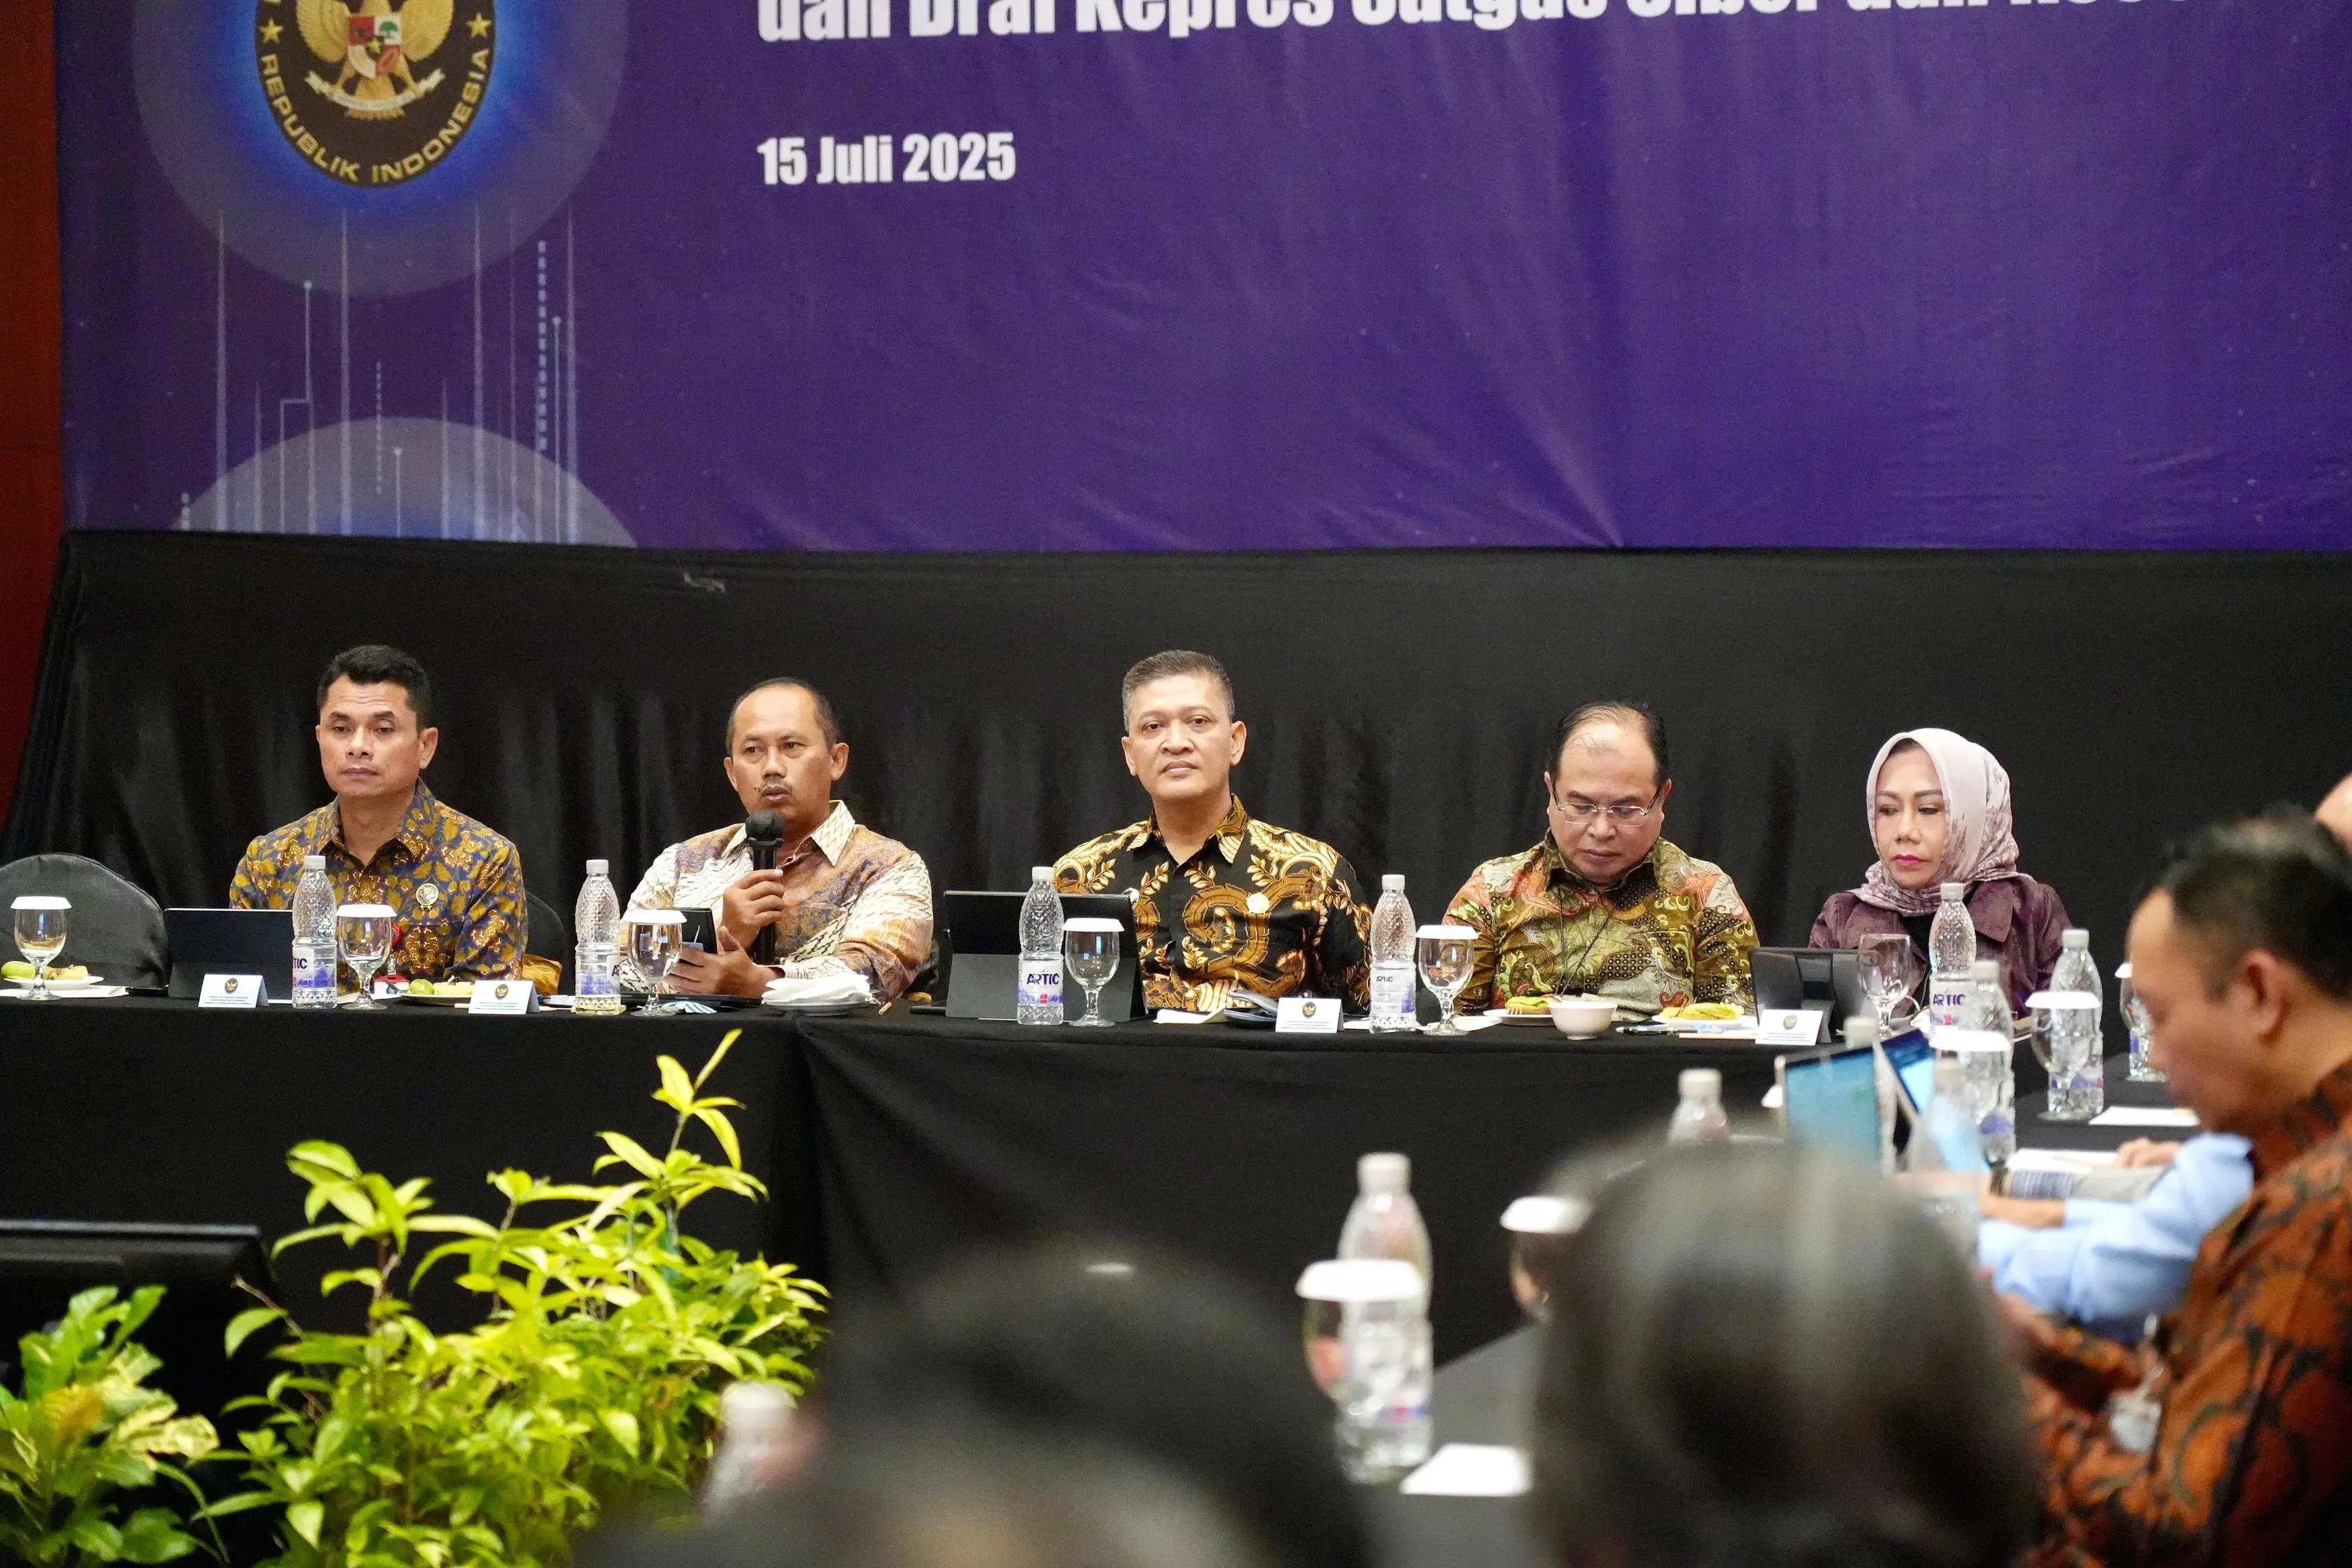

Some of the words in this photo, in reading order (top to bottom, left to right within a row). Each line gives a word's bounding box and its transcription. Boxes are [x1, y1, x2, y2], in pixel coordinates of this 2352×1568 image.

[260, 54, 361, 183] REPUBLIK
[372, 48, 490, 183] INDONESIA
[756, 136, 807, 186] 15
[816, 134, 894, 185] Juli
[902, 132, 1017, 182] 2025
[293, 958, 307, 969] TIC
[1026, 973, 1060, 985] ARTIC
